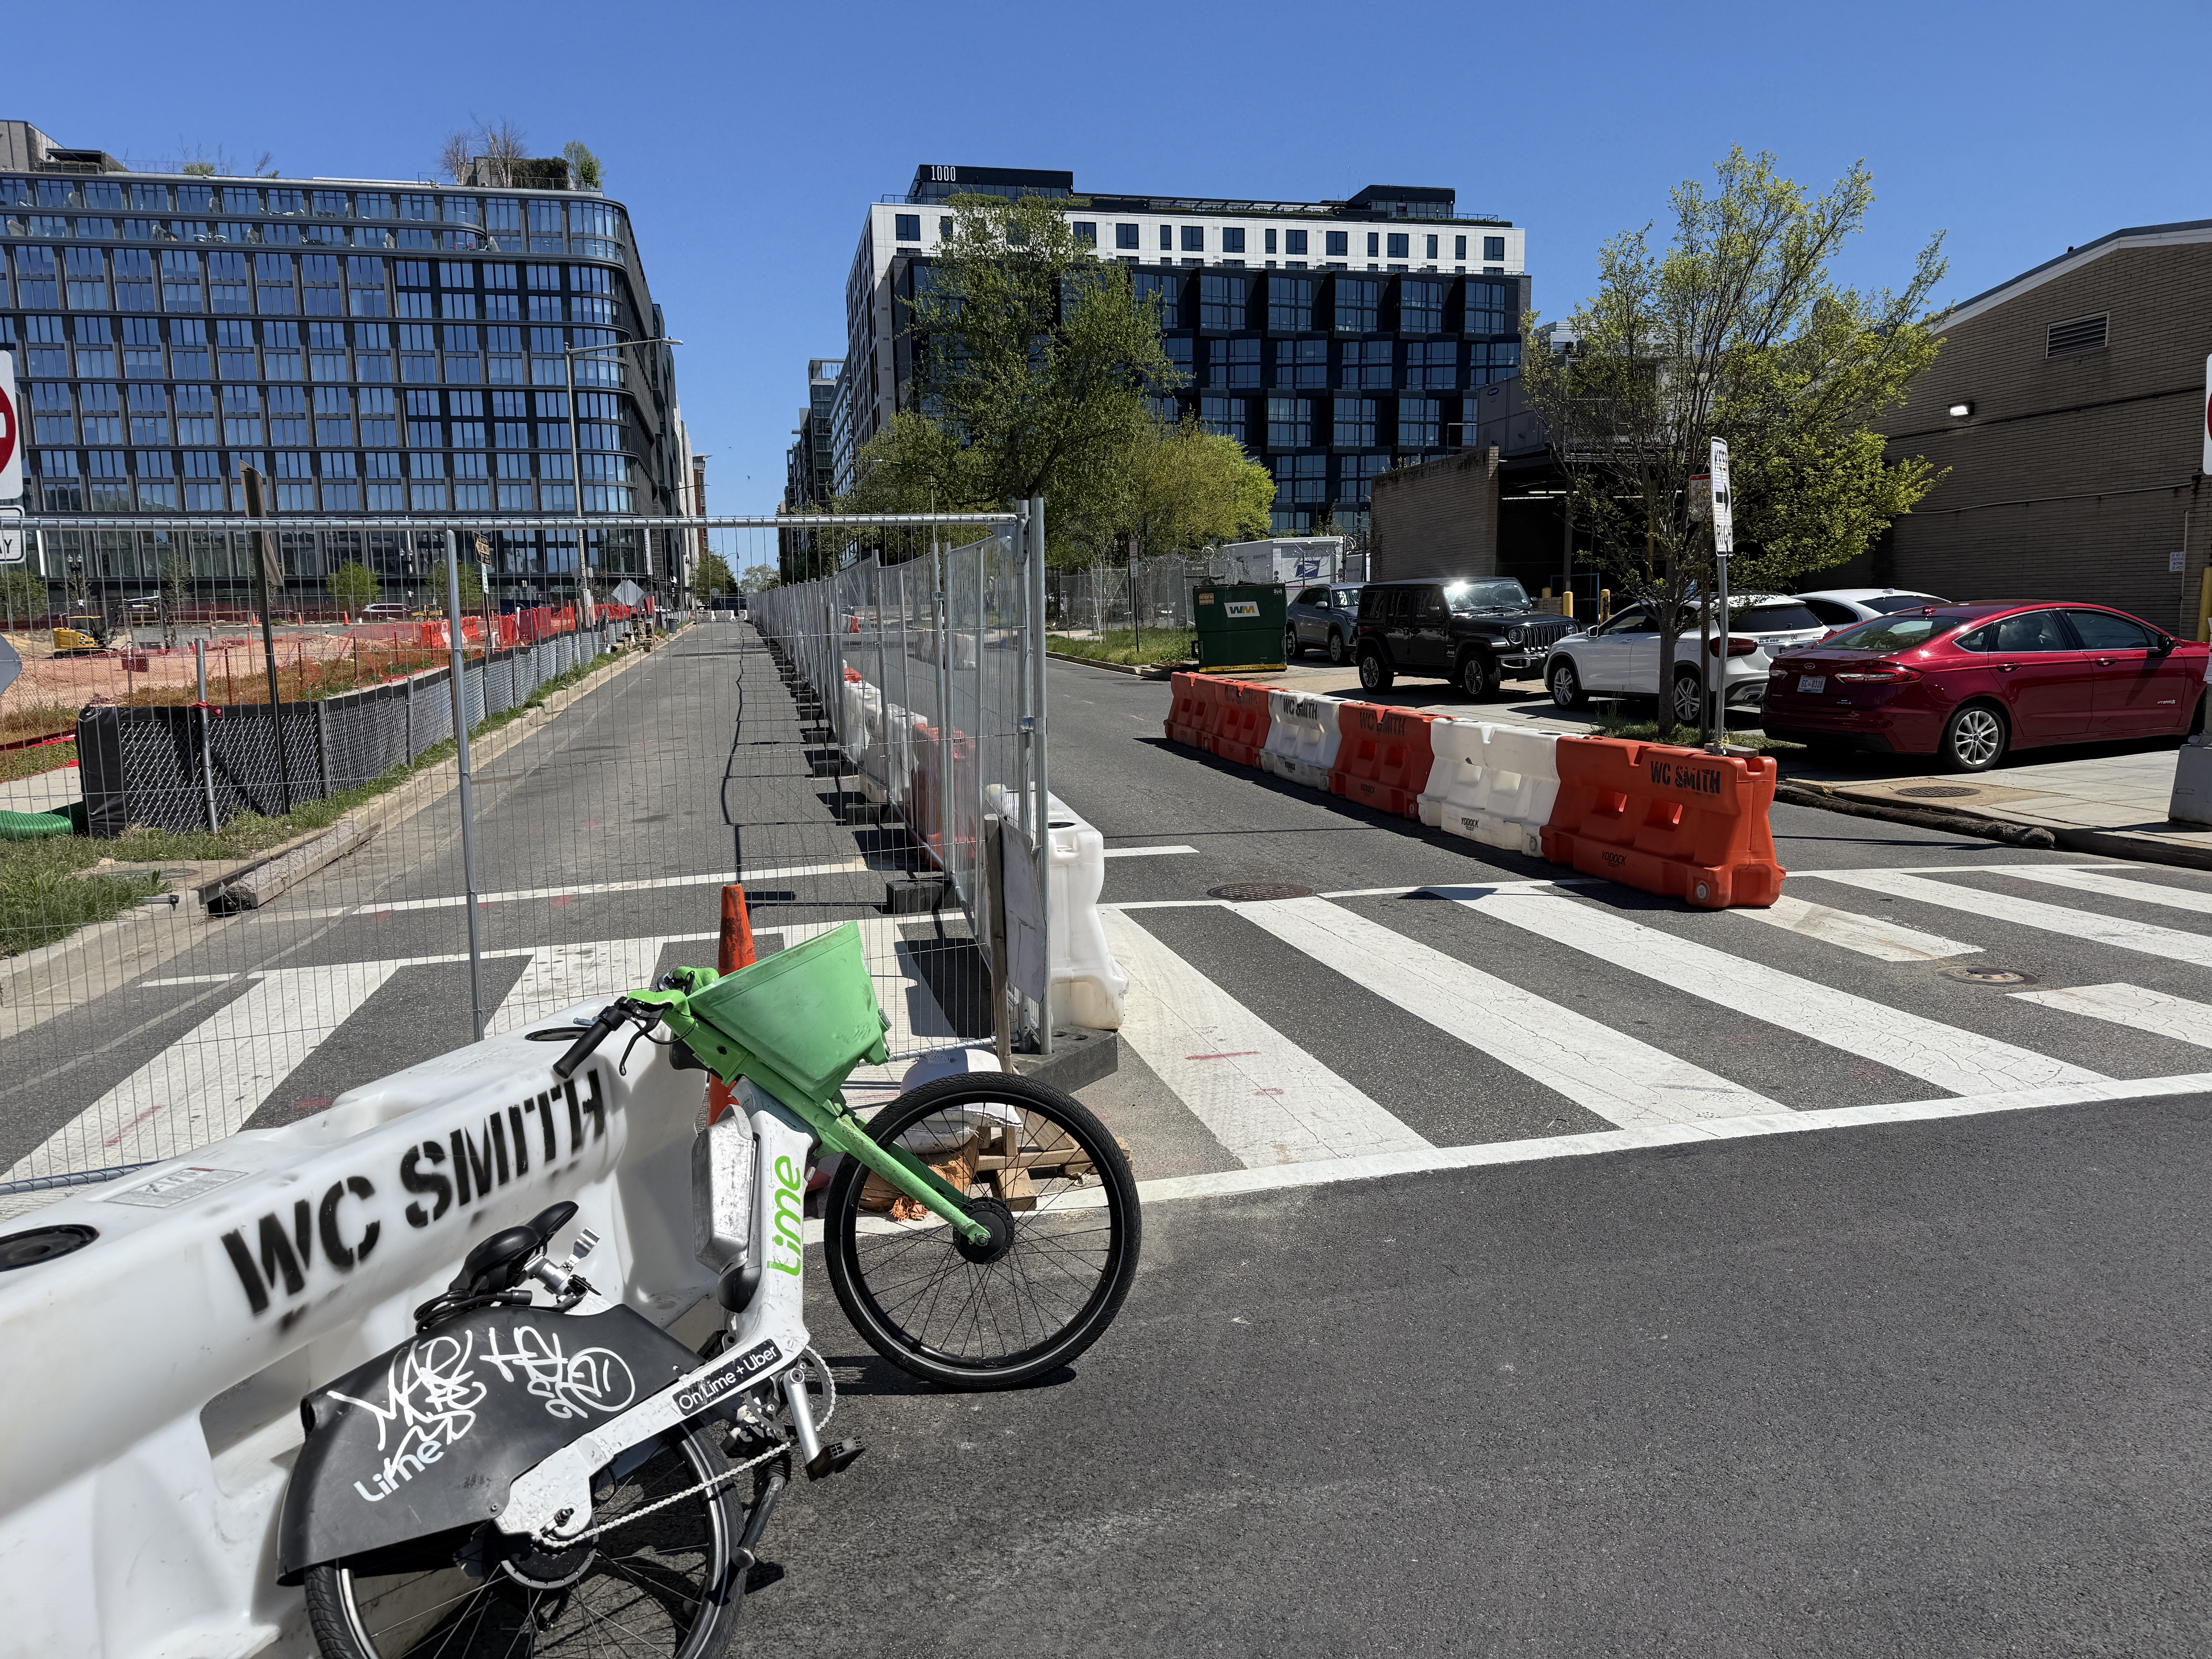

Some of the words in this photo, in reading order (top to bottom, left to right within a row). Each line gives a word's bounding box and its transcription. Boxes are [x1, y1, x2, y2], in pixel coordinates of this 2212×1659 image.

[931, 165, 956, 182] 1000
[1229, 606, 1255, 614] WM
[1283, 697, 1295, 715] WC
[1360, 711, 1375, 731] WC
[1650, 761, 1671, 785] WC
[1675, 764, 1721, 794] SMITH
[1461, 817, 1479, 828] YODOCK
[1602, 850, 1627, 866] YODOCK
[220, 1175, 381, 1317] WC
[400, 1070, 605, 1228] SMITH
[766, 1155, 803, 1276] Lime
[679, 1392, 704, 1410] On
[700, 1372, 736, 1398] Lime
[743, 1346, 777, 1371] Uber
[353, 1439, 445, 1502] Lime
